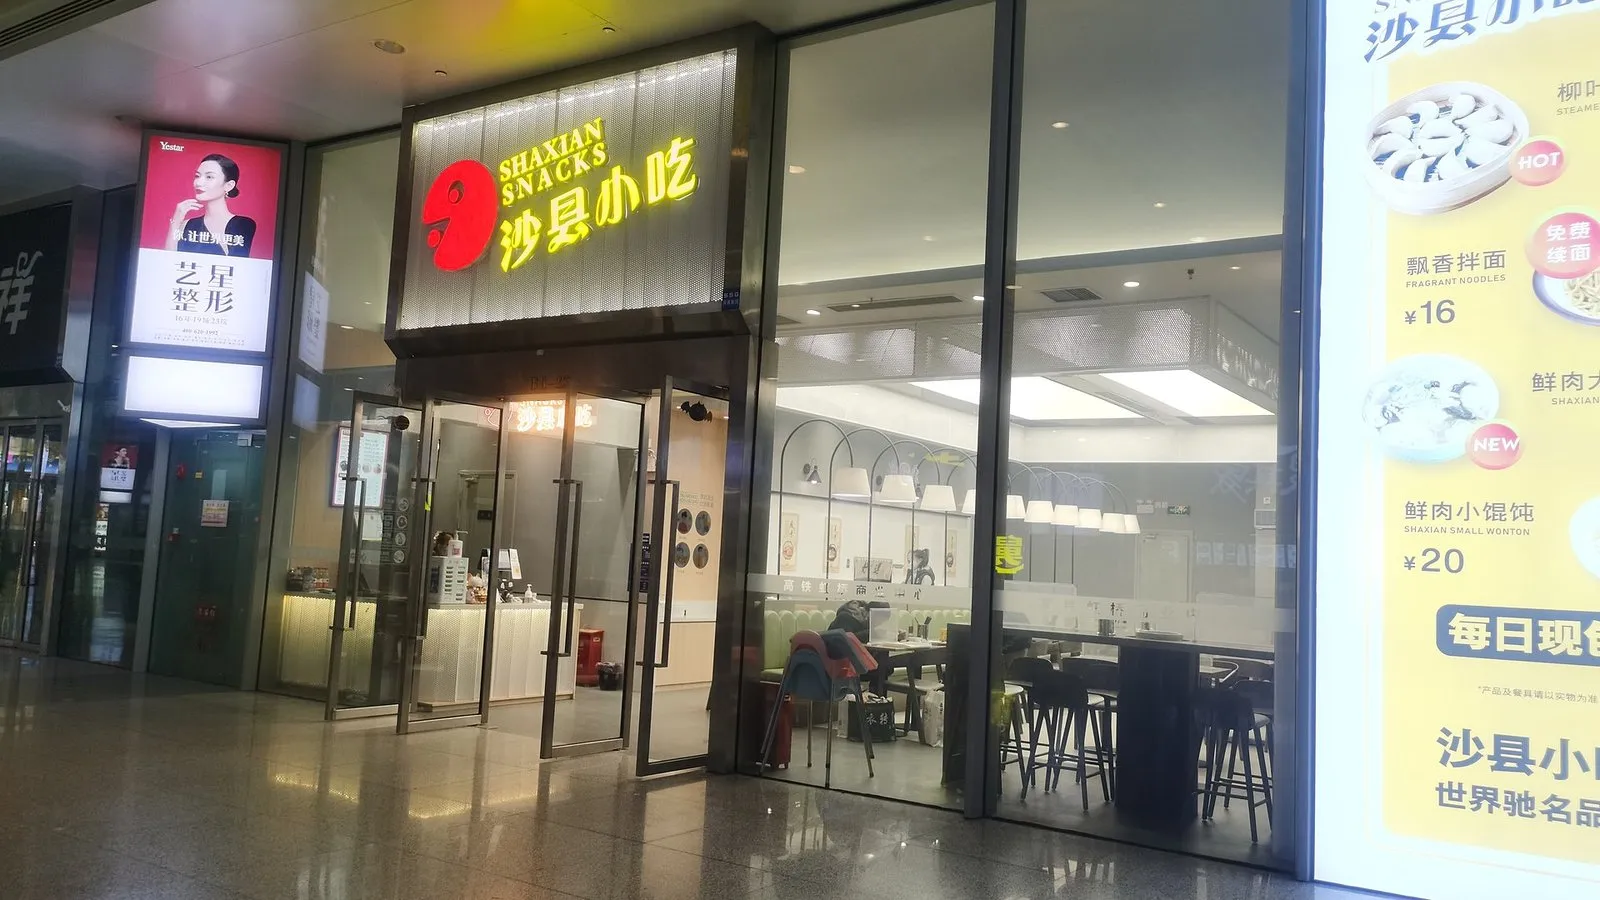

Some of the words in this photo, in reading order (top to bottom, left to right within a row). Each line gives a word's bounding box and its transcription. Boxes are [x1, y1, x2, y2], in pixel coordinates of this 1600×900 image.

[1364, 0, 1600, 63] 沙县
[499, 117, 603, 182] SHAXIAN
[1518, 152, 1560, 169] HOT
[501, 142, 607, 206] SNACKS
[500, 137, 697, 273] 沙县小吃
[1547, 221, 1591, 241] 免费
[173, 261, 235, 289] 艺星
[1406, 250, 1507, 276] 飘香拌面
[1406, 278, 1457, 289] FRAGRANT
[1459, 274, 1506, 284] NOODLES
[170, 288, 235, 314] 整形
[1404, 299, 1456, 325] ¥16
[1551, 396, 1600, 405] SHAXIAN
[1473, 437, 1520, 452] NEW
[1404, 501, 1535, 522] 鲜肉小馄饨
[1404, 525, 1447, 535] SHAXIAN
[1449, 526, 1484, 535] SMALL
[1486, 528, 1530, 536] WONTON
[1403, 547, 1465, 574] ¥20
[1436, 726, 1600, 781] 沙县小
[1435, 781, 1600, 828] 世界驰名品
